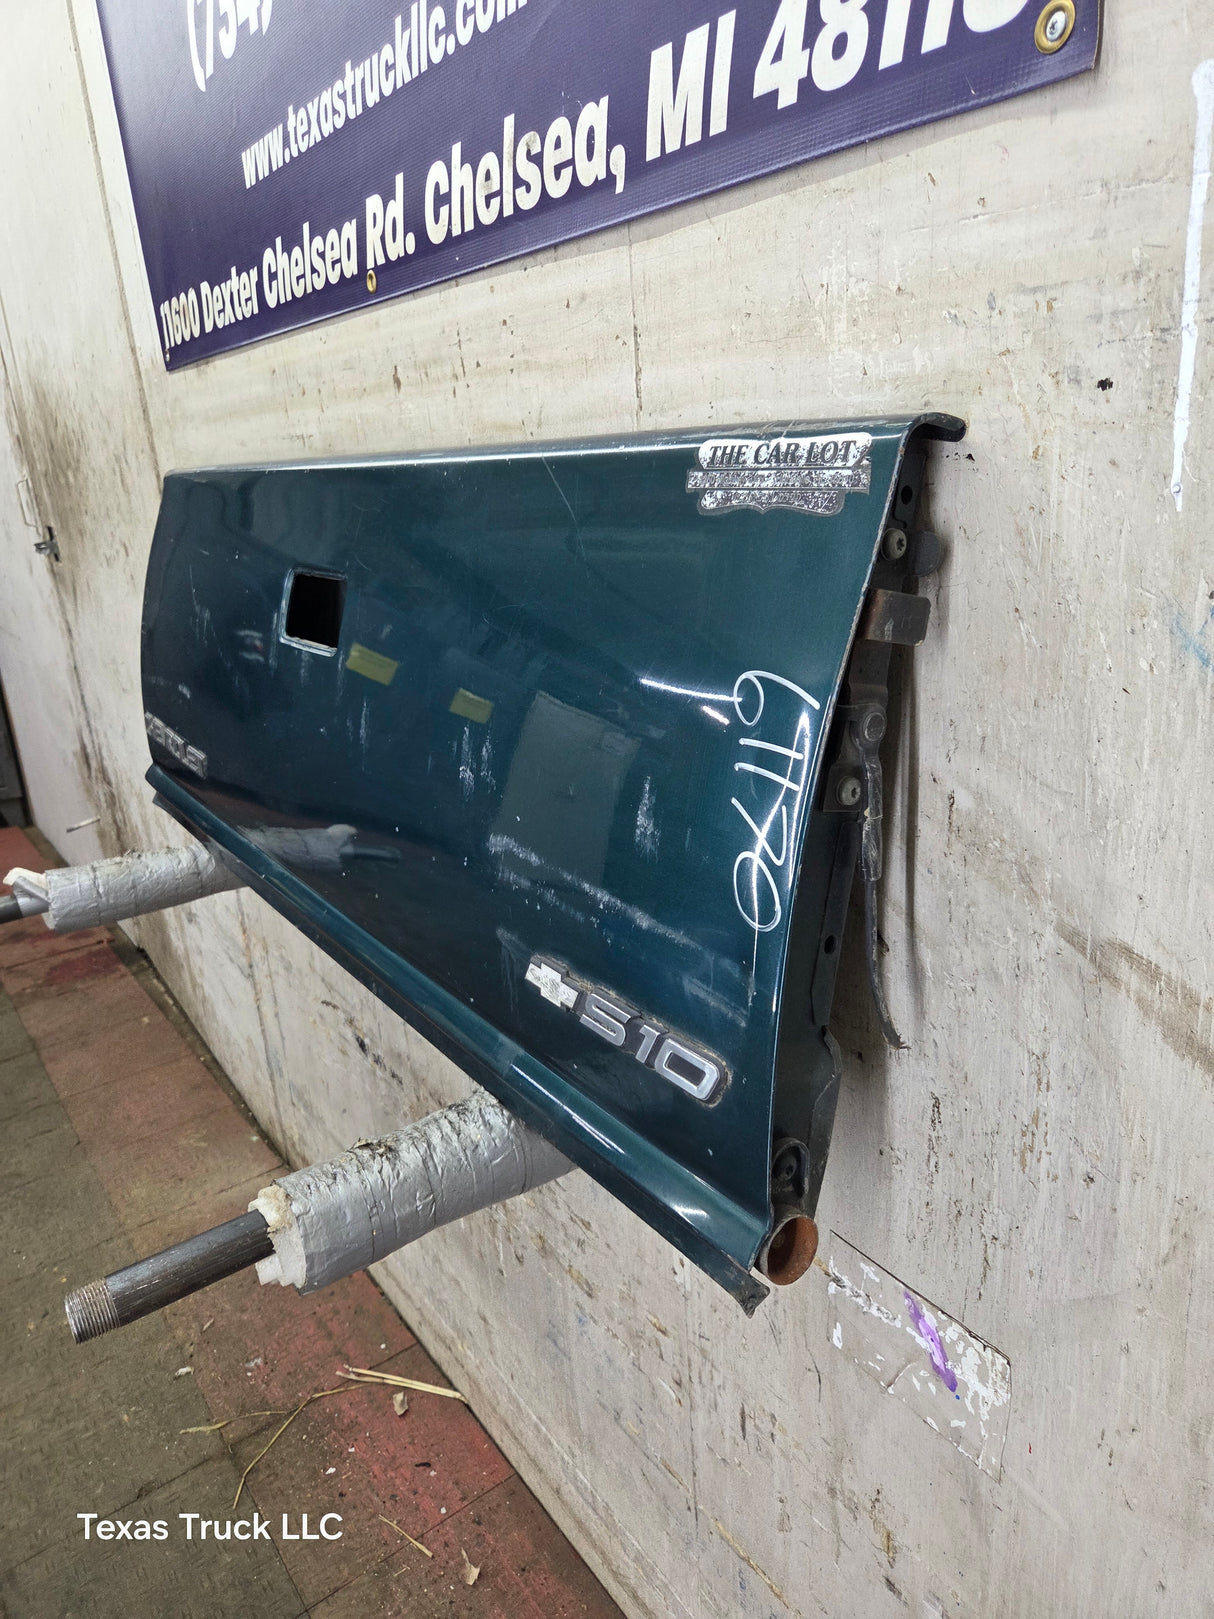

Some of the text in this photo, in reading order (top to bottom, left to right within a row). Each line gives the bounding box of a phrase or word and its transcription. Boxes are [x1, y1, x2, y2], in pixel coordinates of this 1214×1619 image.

[160, 0, 1028, 350] 11600 Dexter Chelsea Rd. Chelsea, MI 481
[707, 440, 857, 465] THE CAR LOT
[579, 993, 720, 1101] S10
